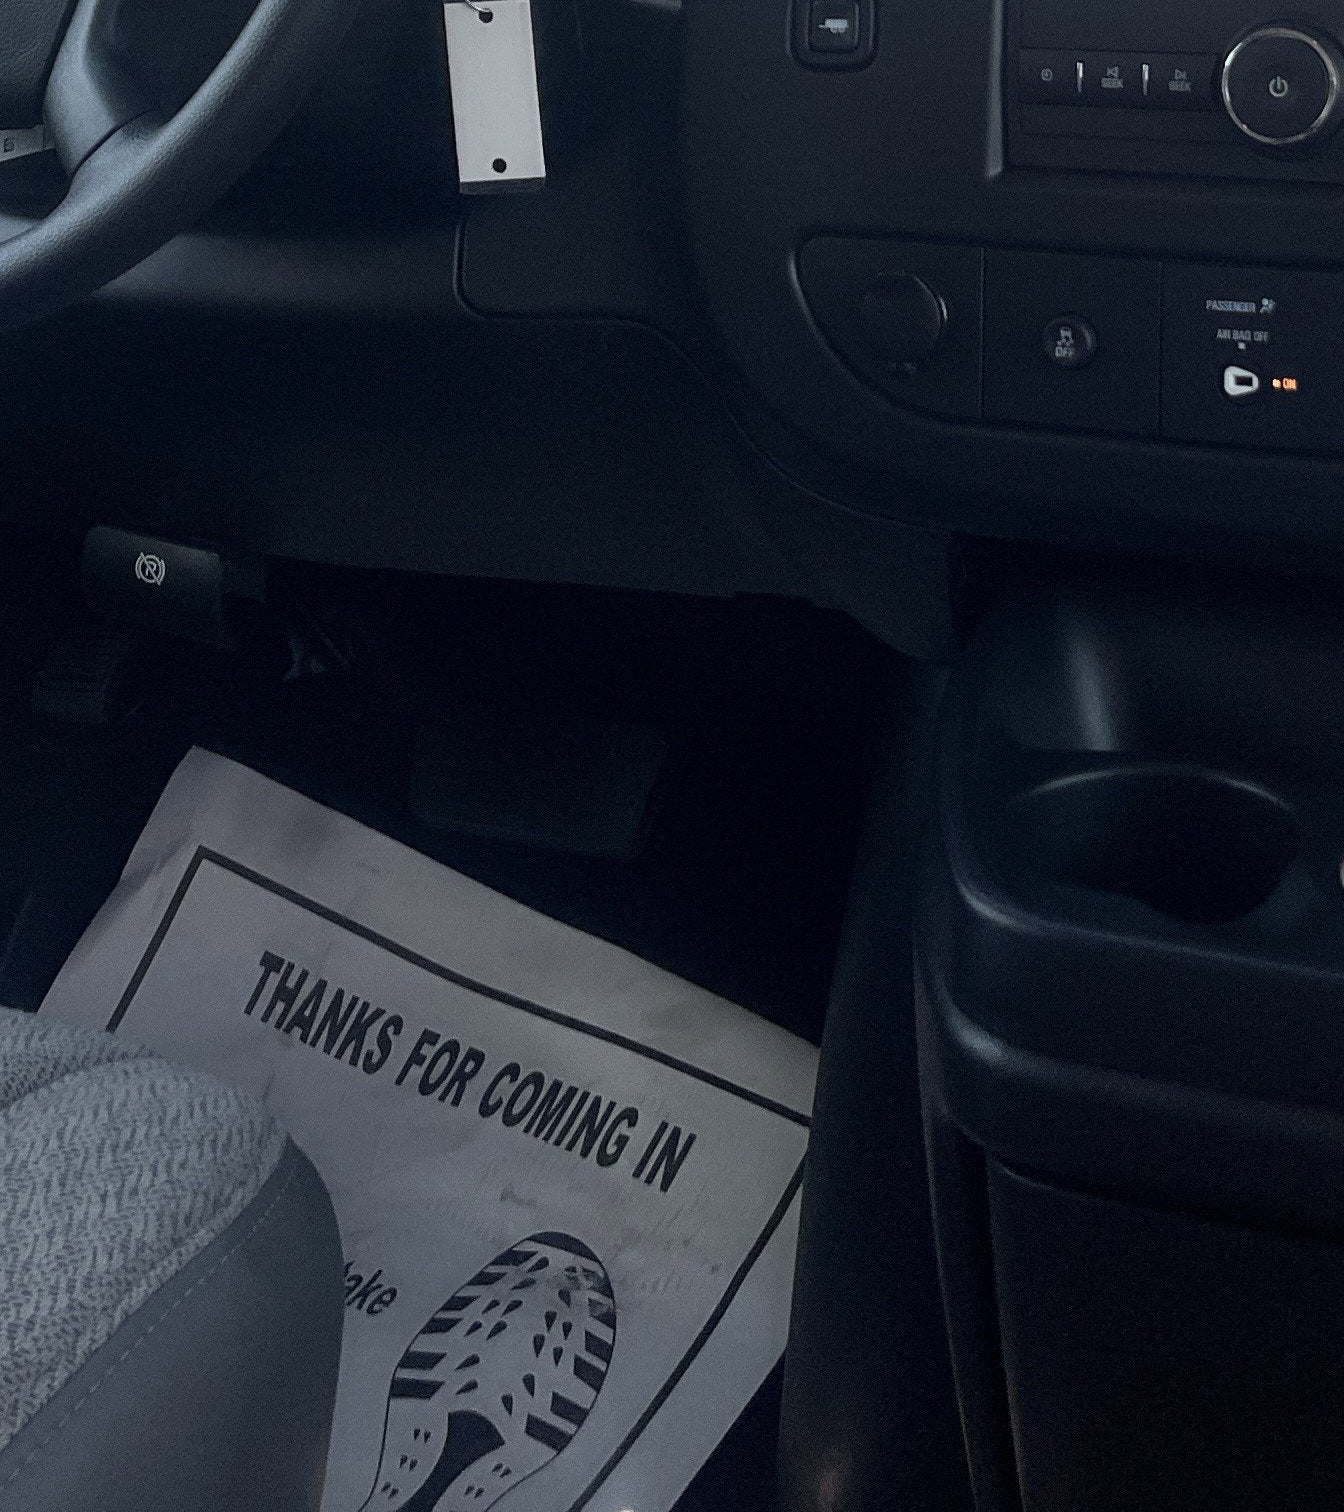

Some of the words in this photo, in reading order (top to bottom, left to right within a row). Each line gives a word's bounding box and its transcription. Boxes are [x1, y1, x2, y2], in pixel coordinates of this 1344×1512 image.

[1205, 300, 1256, 313] PASSENGER
[1217, 329, 1231, 340] AIR
[1232, 329, 1252, 341] BAG
[243, 950, 404, 1076] THANKS
[394, 1027, 487, 1109] FOR
[477, 1061, 641, 1168] COMING
[631, 1120, 697, 1193] IN
[343, 1259, 398, 1316] ake
